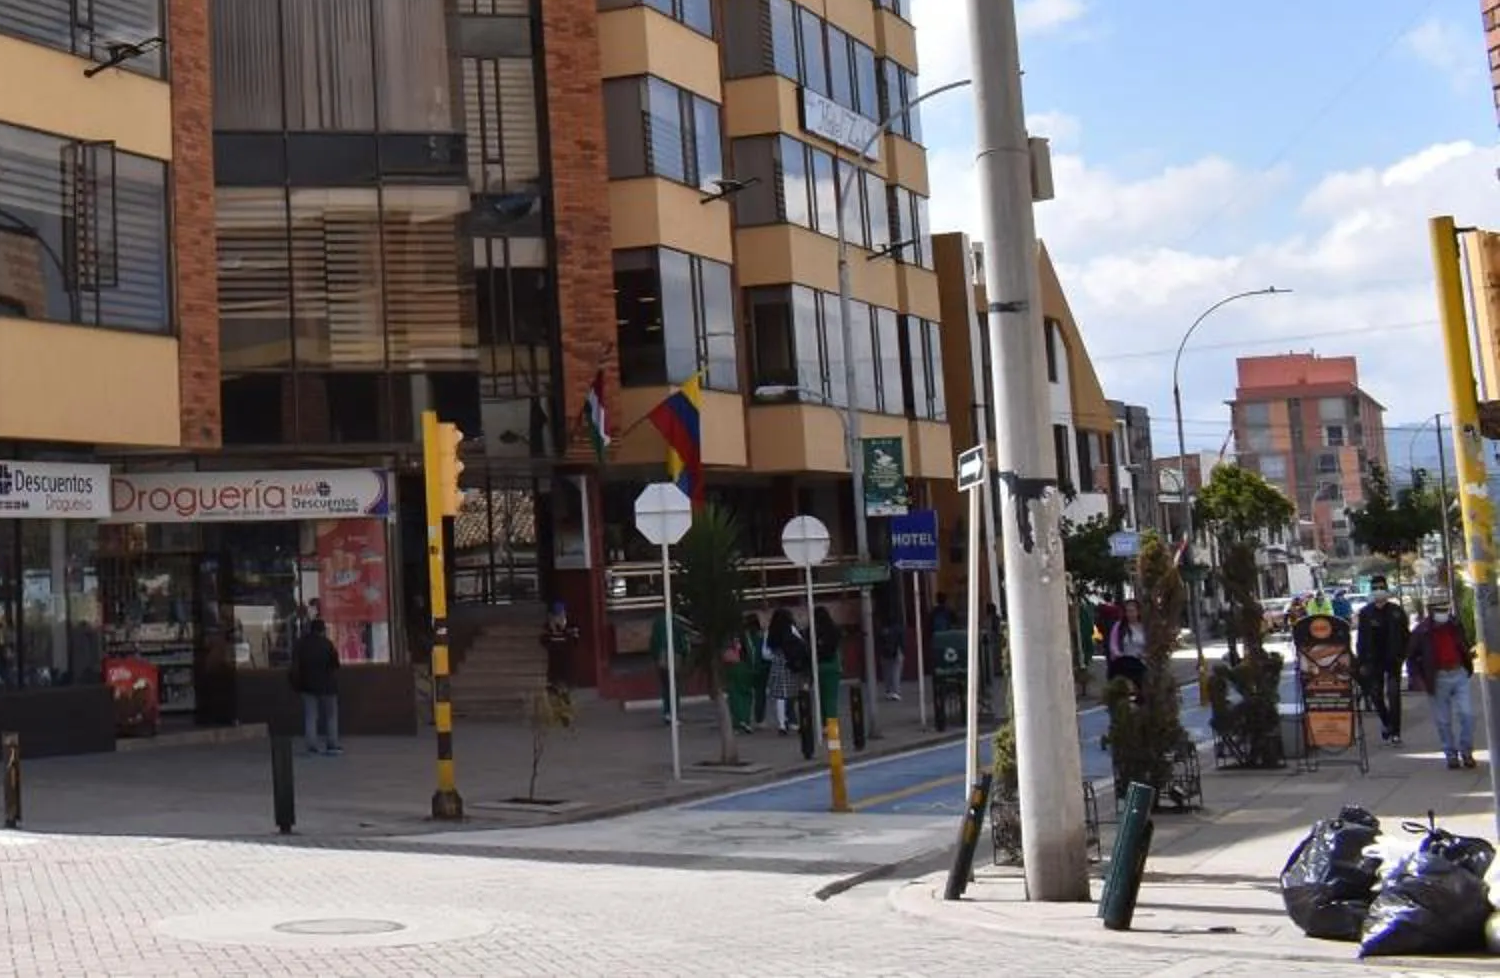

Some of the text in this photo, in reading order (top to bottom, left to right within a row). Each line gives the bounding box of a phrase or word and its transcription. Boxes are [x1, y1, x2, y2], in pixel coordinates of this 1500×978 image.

[14, 469, 93, 494] Descuentos
[111, 478, 287, 517] Droguería
[290, 497, 359, 510] Descuentos
[891, 532, 935, 547] HOTEL
